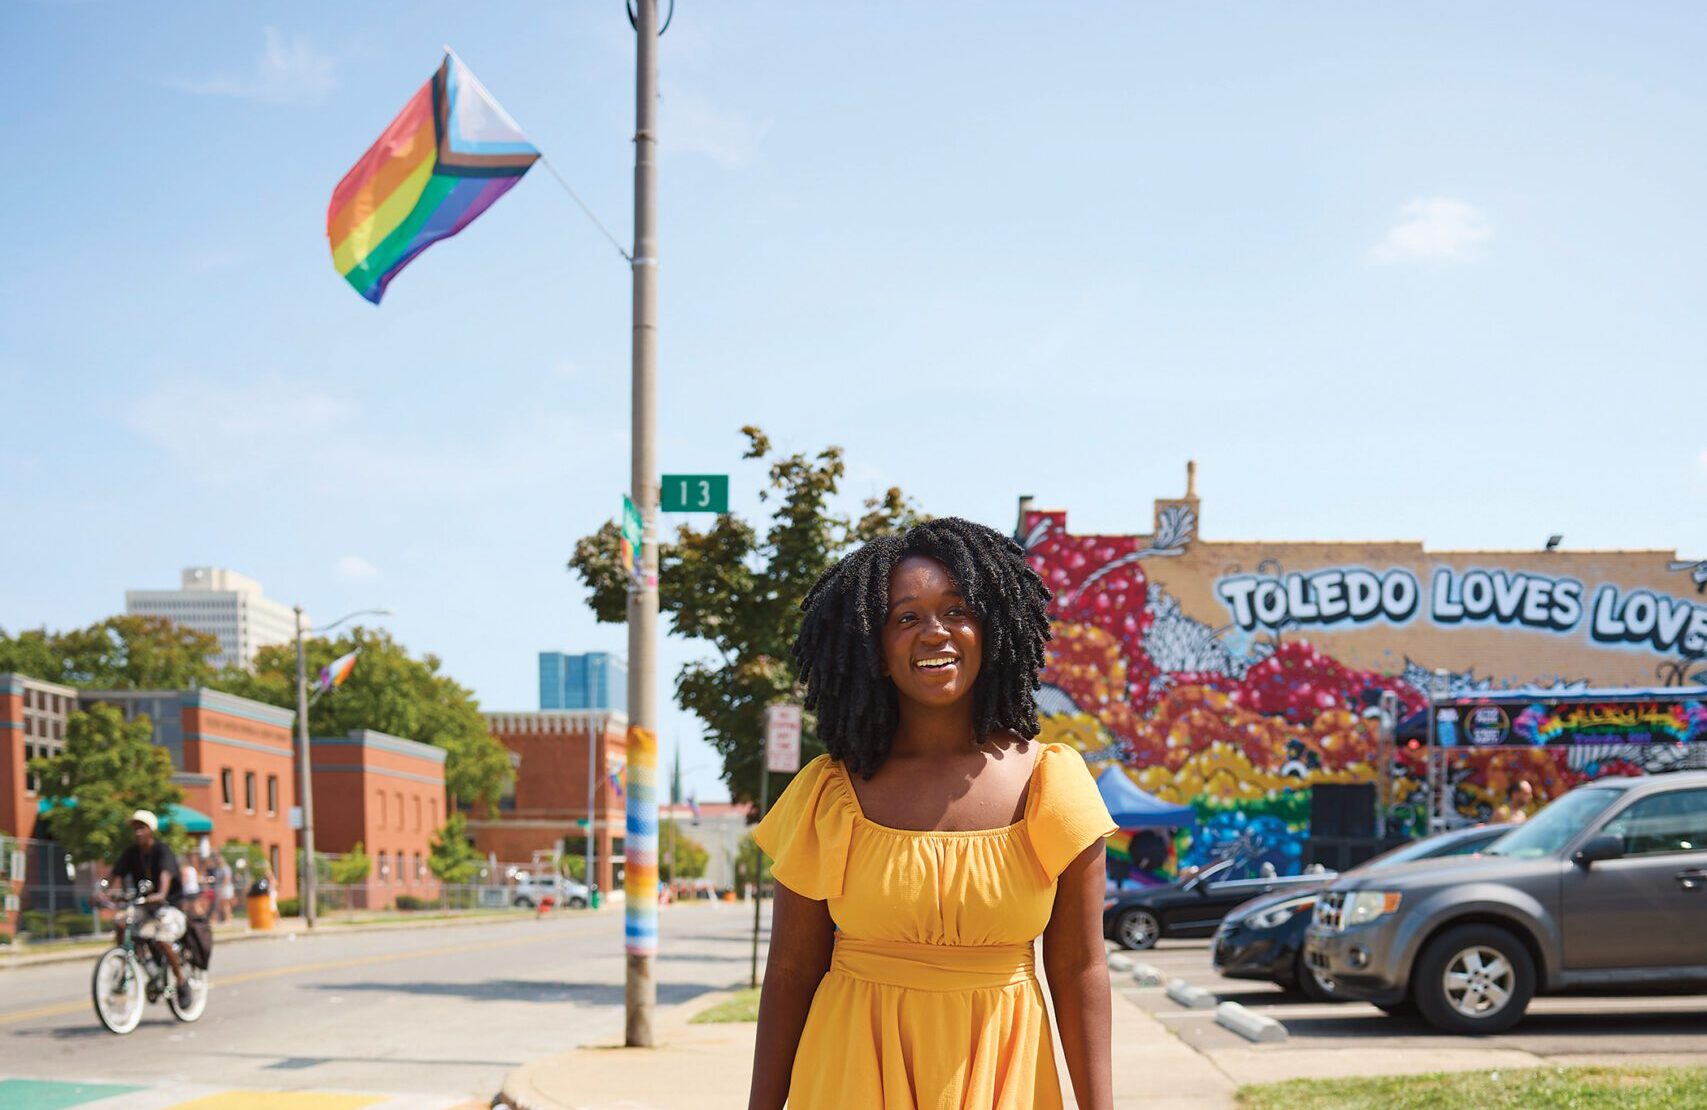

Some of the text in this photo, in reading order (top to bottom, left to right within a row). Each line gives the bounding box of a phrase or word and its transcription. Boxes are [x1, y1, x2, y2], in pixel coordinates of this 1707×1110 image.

[680, 481, 711, 507] 13
[1219, 569, 1707, 657] TOLEDO LOVES LOVE
